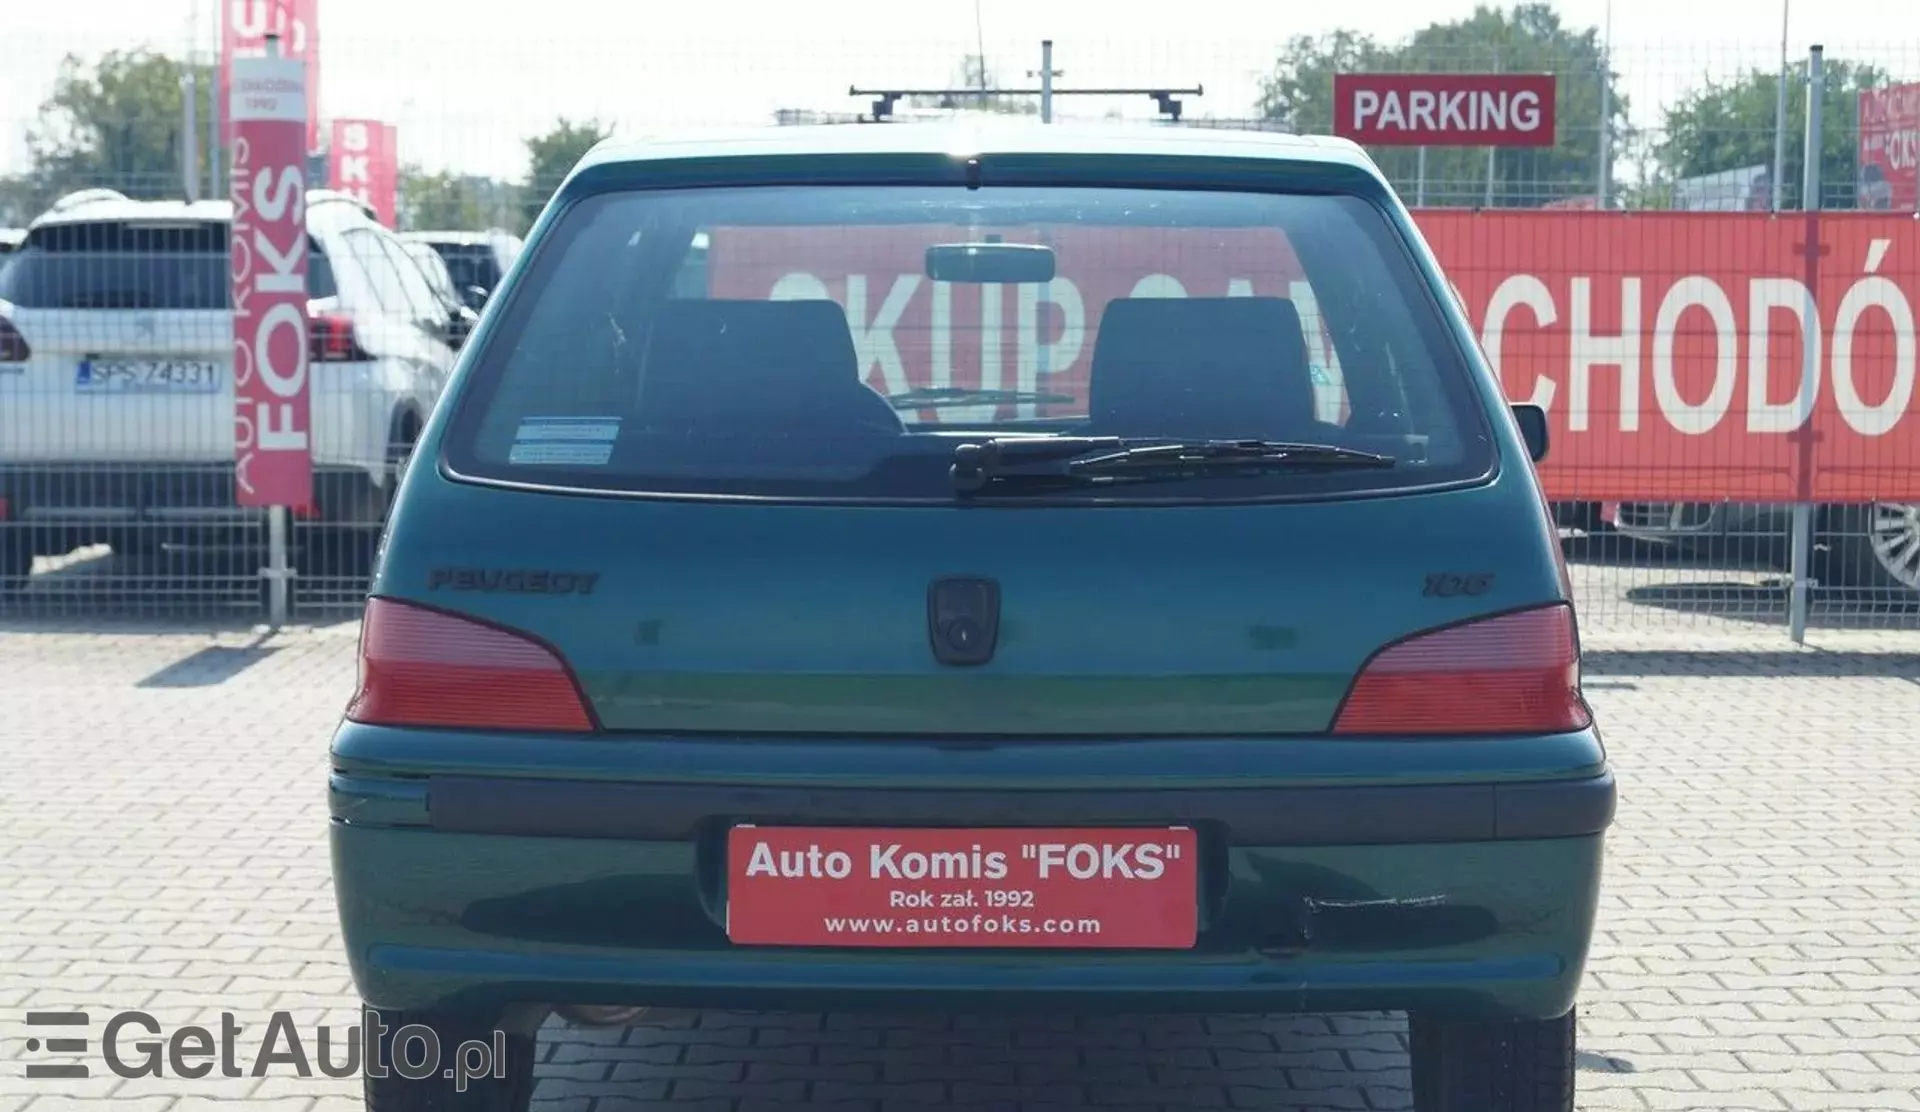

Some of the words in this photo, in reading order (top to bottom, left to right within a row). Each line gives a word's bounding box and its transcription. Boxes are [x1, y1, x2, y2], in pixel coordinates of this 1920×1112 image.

[1353, 90, 1541, 132] PARKING
[251, 164, 308, 450] FOKS
[769, 272, 1085, 424] KUP
[428, 566, 600, 595] PEUGEOT
[1422, 572, 1496, 598] 106
[745, 842, 852, 880] Auto
[869, 843, 1009, 880] Komis
[1021, 843, 1182, 880] "FOKS"
[889, 889, 934, 908] Rok
[940, 889, 979, 909] zał.
[984, 889, 1035, 908] 1992
[824, 914, 1101, 935] www.autofoks.com
